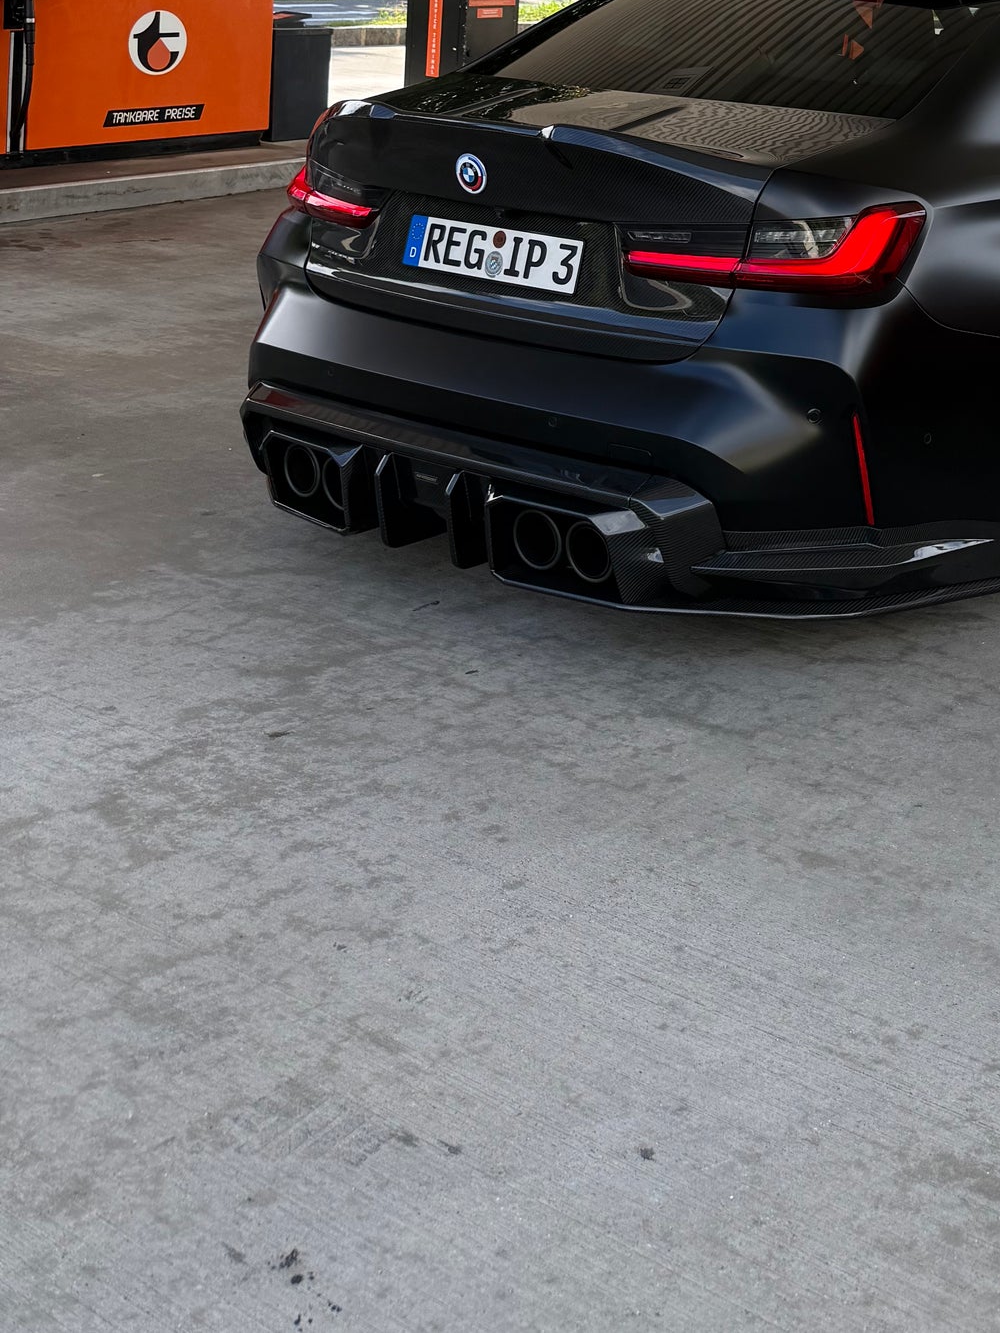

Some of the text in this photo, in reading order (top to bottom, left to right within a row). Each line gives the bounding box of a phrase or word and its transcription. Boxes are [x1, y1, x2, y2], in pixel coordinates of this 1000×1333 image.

[112, 106, 196, 124] TANKBARE PREISE
[409, 246, 417, 258] D
[423, 223, 579, 285] REG IP 3
